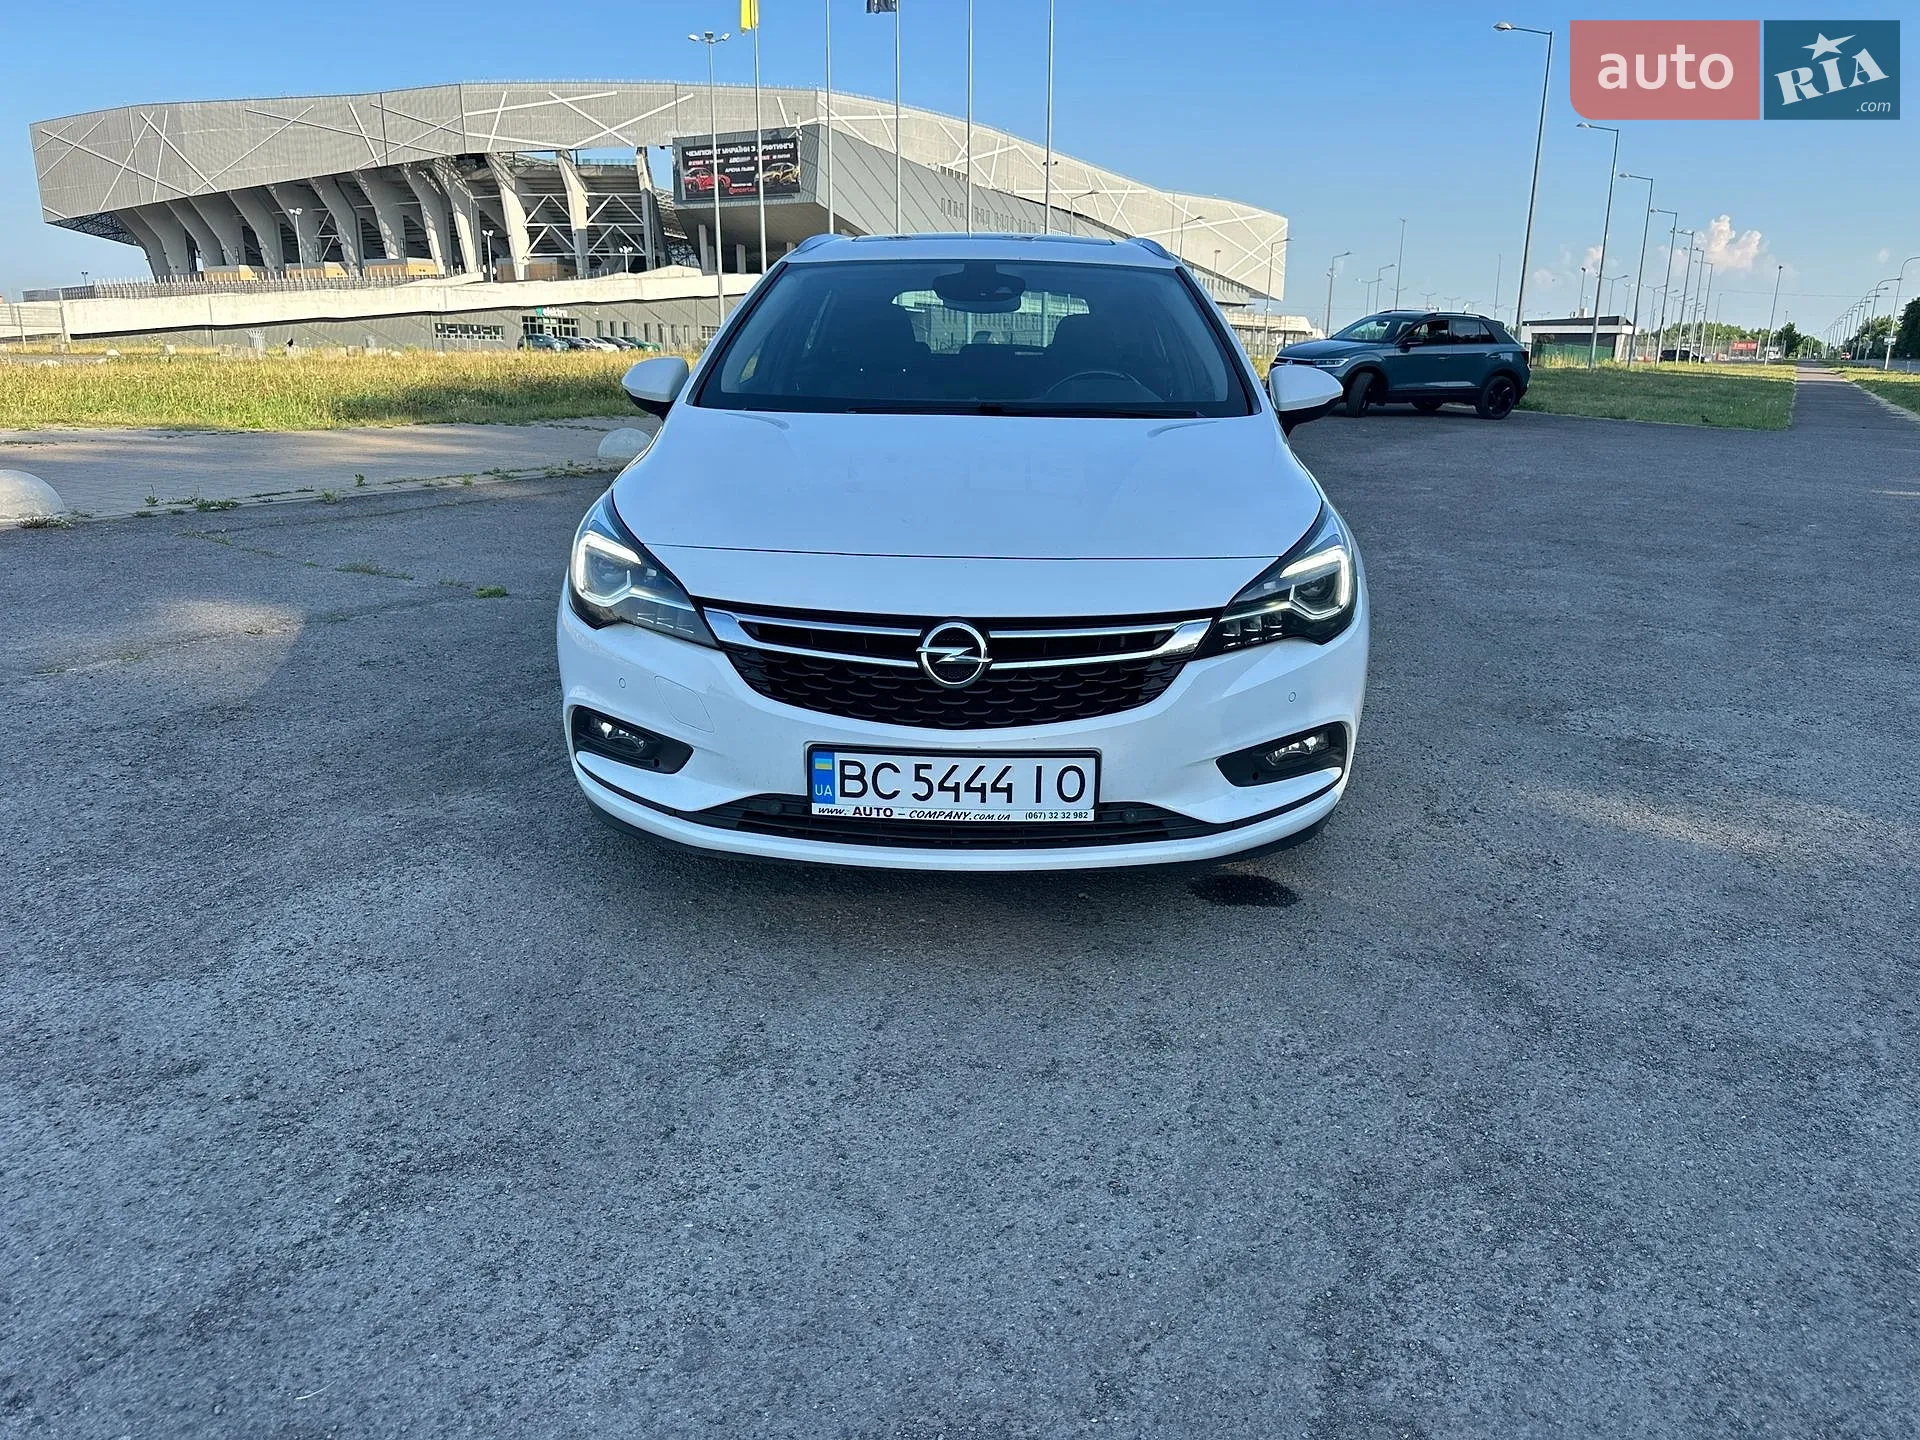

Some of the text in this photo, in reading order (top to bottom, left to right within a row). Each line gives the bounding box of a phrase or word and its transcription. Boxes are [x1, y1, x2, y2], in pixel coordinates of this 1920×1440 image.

[686, 148, 721, 157] ЧЕМПІОНТ
[815, 759, 1086, 804] UA BC 5444 IO
[818, 807, 847, 815] www.
[852, 806, 894, 817] AUTO
[1025, 811, 1046, 820] (067)
[1049, 811, 1058, 820] 32
[1061, 811, 1070, 820] 32
[1073, 811, 1088, 820] 982
